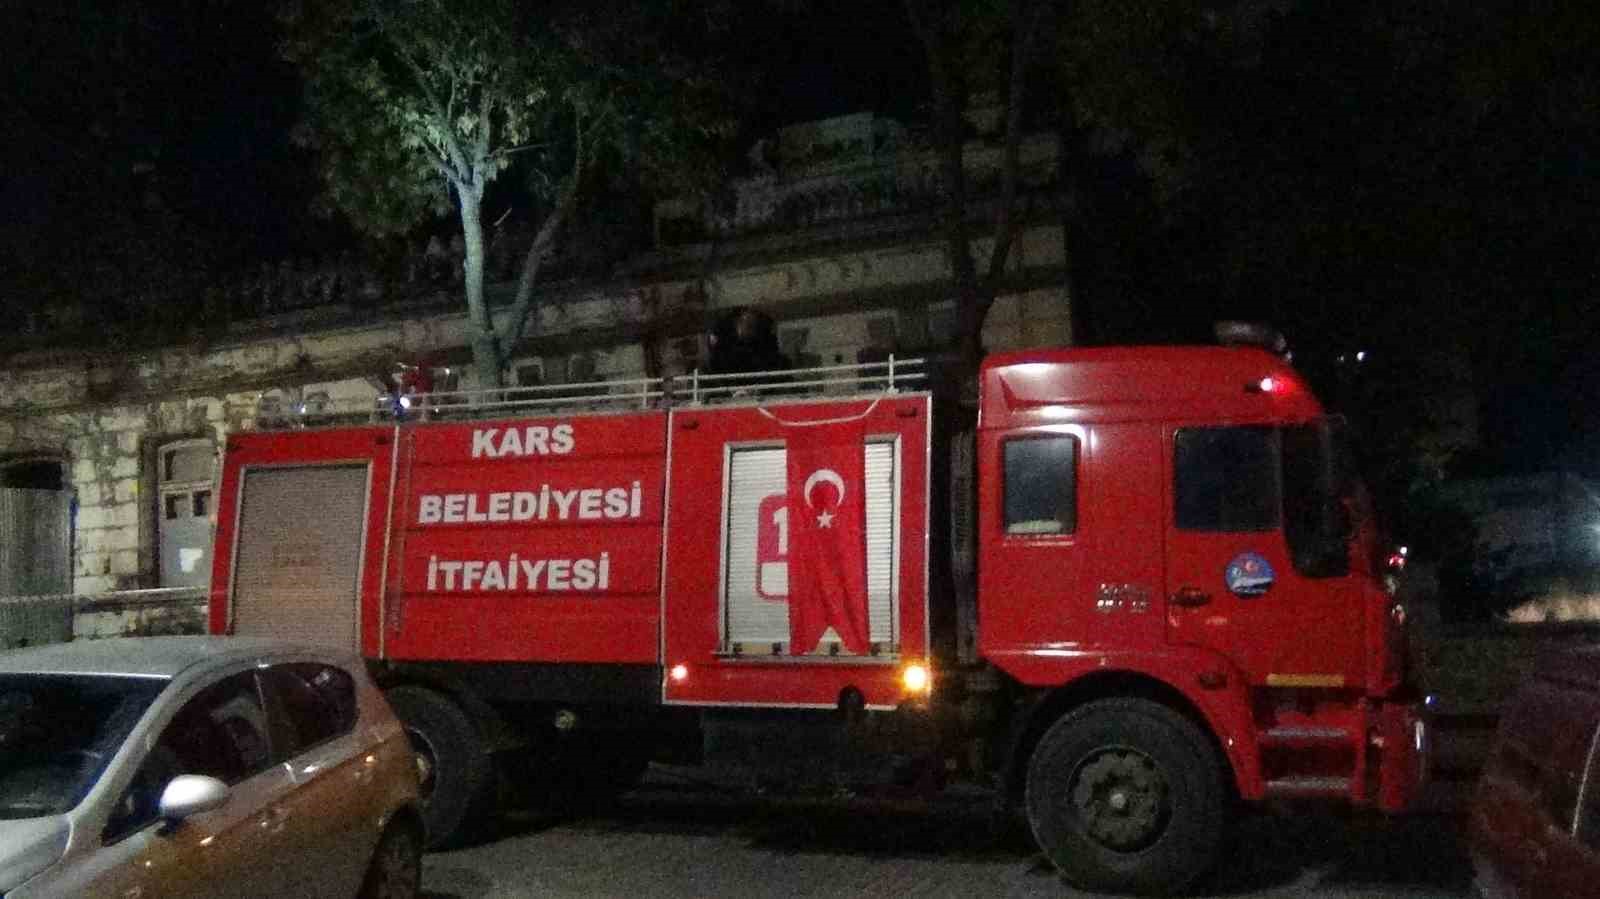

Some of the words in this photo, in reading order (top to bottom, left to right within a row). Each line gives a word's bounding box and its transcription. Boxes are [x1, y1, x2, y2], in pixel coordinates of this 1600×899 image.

[472, 424, 575, 458] KARS
[418, 480, 642, 523] BELEDİYESİ
[426, 551, 609, 591] İTFAİYESİ
